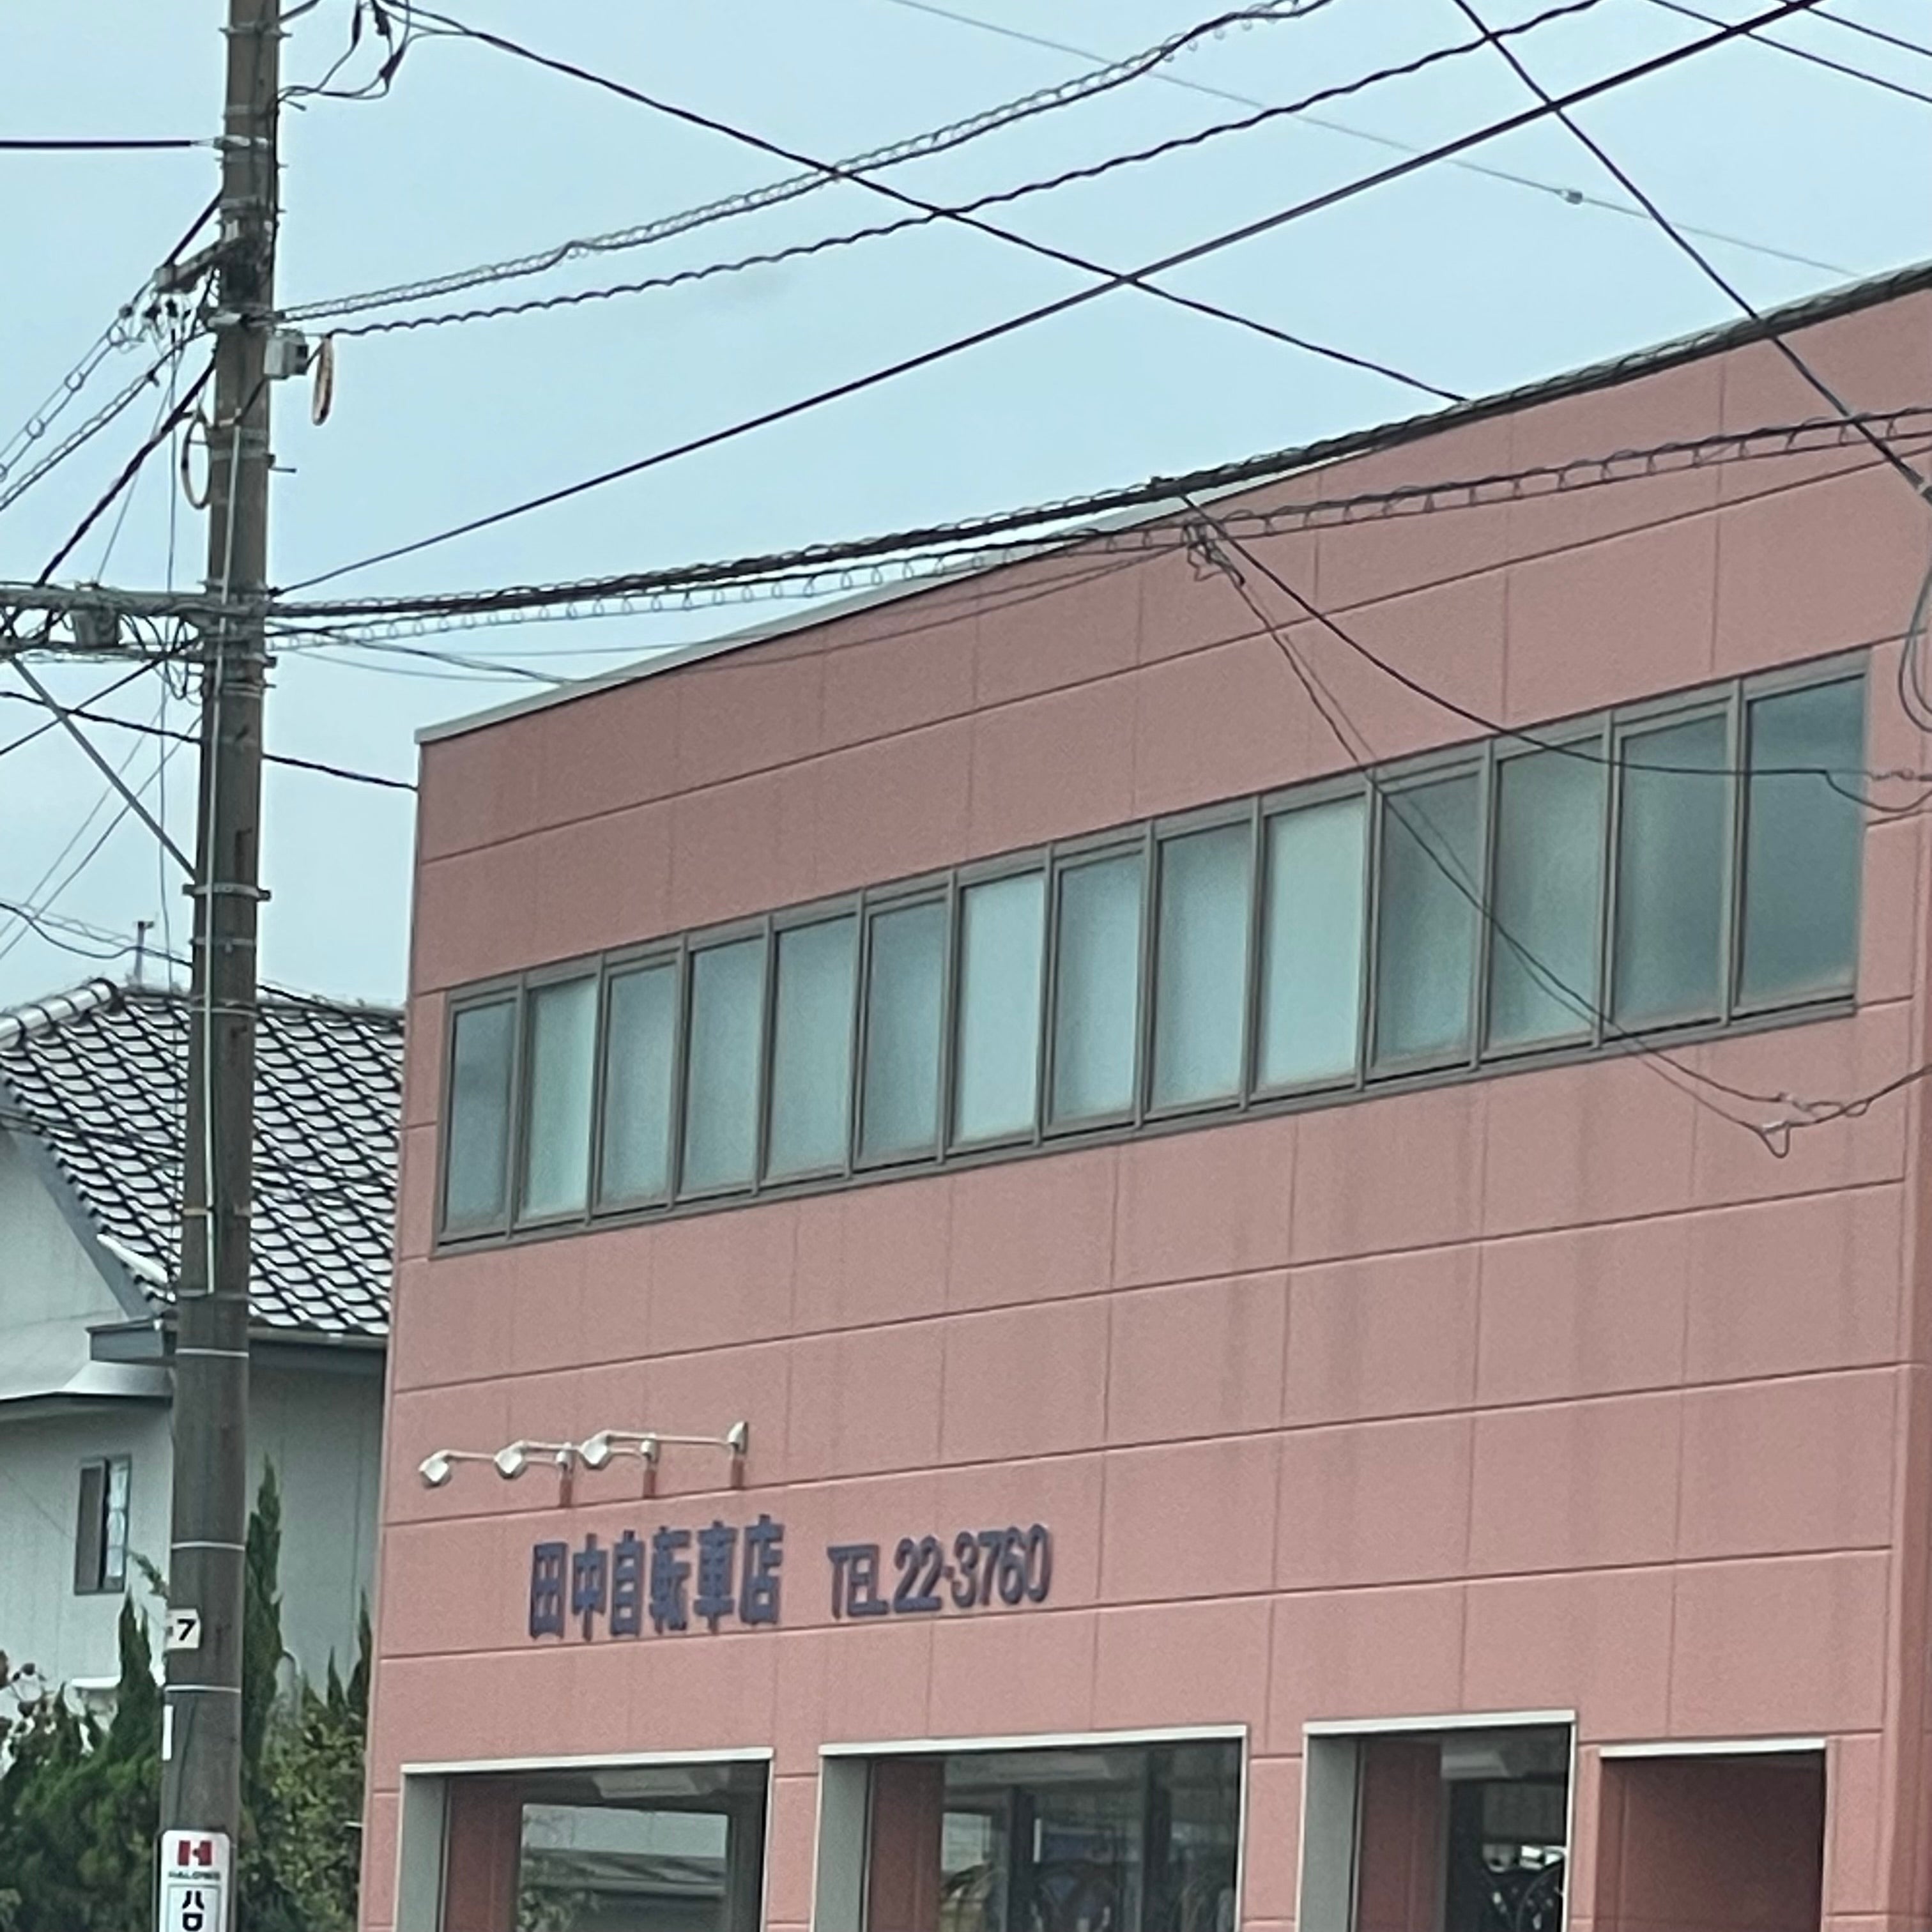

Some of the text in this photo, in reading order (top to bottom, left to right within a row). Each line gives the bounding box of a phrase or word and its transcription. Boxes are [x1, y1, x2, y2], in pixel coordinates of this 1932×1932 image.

[530, 1514, 1052, 1642] 田中自転車店 TEL 22-3760
